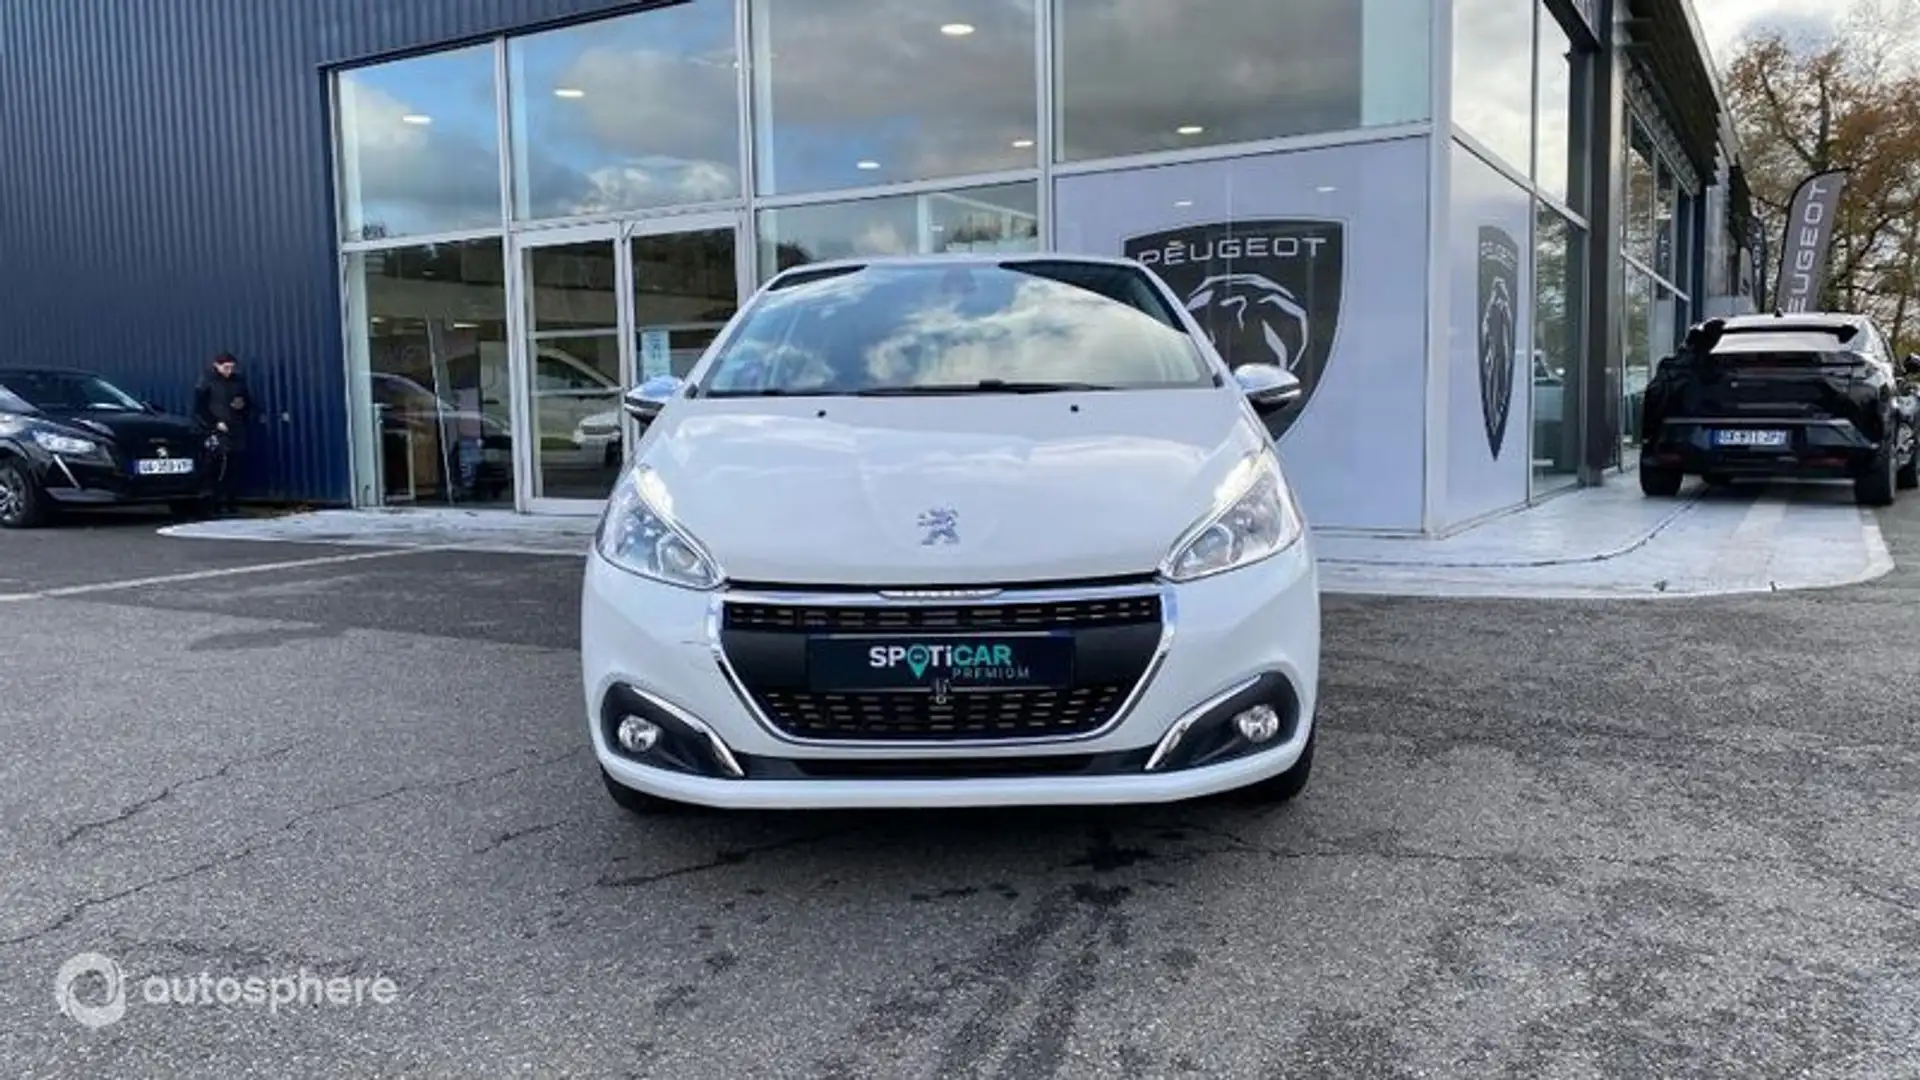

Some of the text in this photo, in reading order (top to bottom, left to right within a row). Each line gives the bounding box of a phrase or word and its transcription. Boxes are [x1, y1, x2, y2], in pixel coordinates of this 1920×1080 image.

[1137, 237, 1327, 266] PEUGEOT
[1787, 180, 1828, 314] EUGEOT
[952, 665, 1031, 680] PREMIUM
